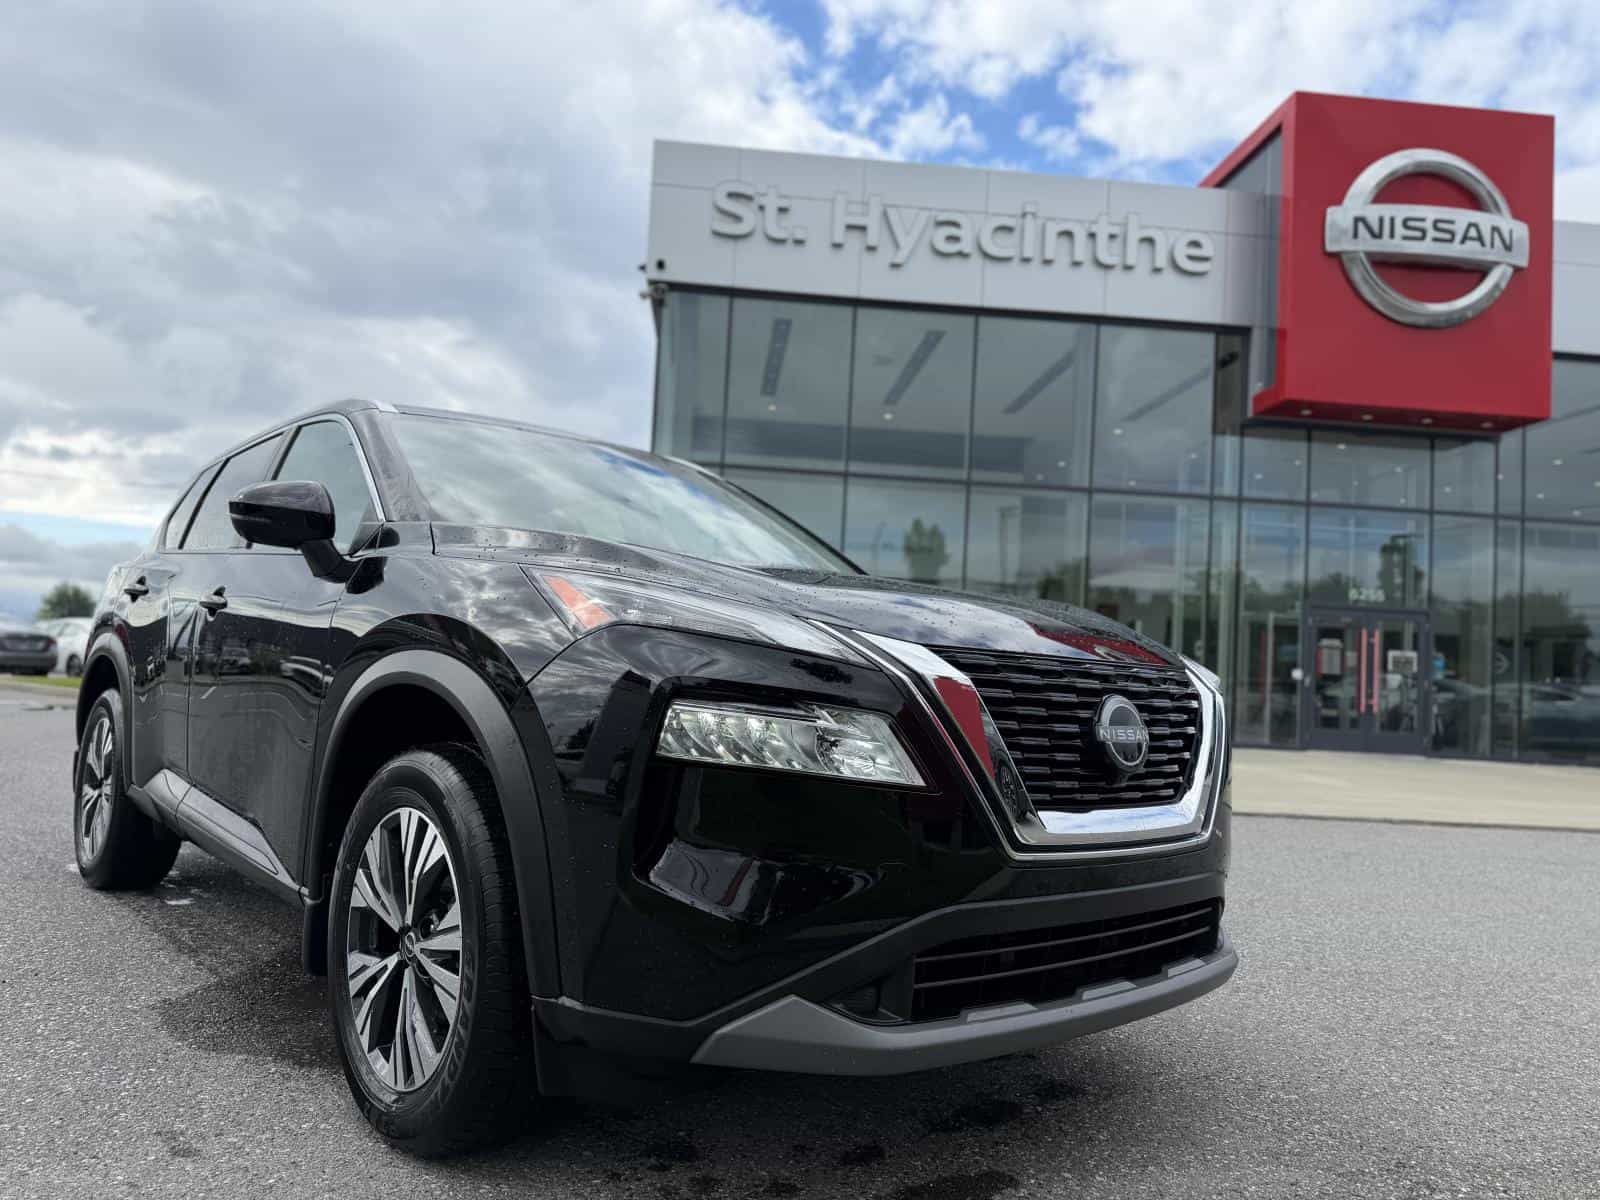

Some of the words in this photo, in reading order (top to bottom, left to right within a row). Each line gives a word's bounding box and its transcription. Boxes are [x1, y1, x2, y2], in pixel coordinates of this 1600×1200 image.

[711, 180, 807, 246] St.
[829, 192, 1214, 276] Hyacinthe
[1352, 215, 1513, 252] NISSAN
[1100, 728, 1148, 743] NISSAN
